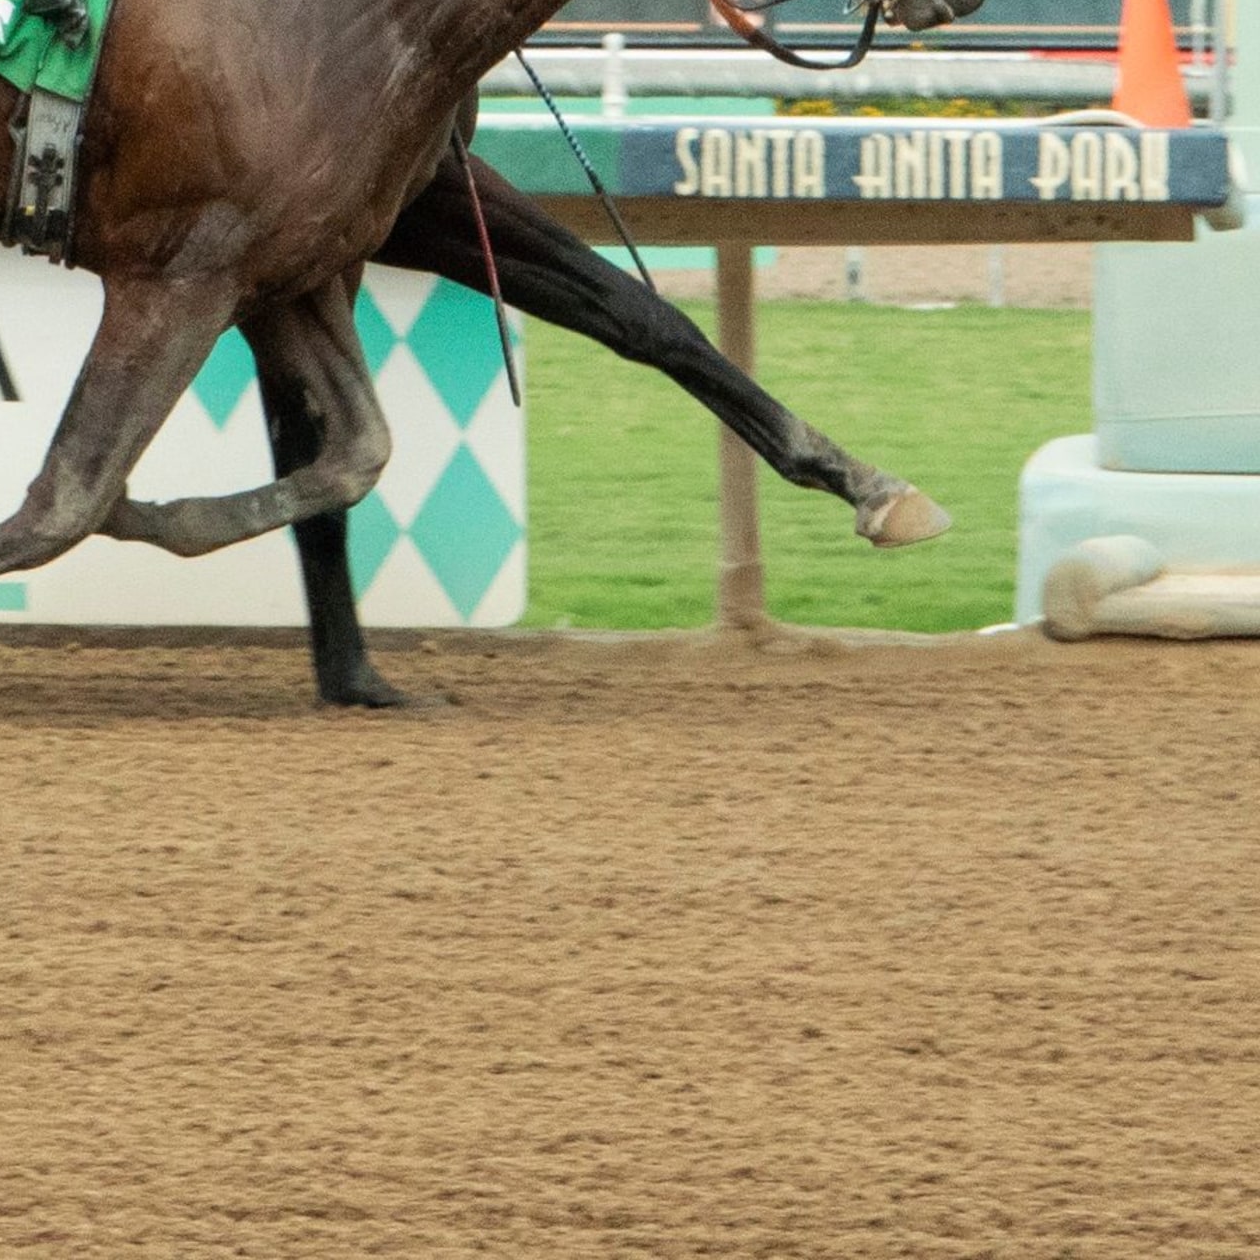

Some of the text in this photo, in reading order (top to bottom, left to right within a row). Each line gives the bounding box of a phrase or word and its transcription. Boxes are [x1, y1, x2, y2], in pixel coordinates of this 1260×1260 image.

[674, 128, 1170, 201] SANTA ANITA PARK
